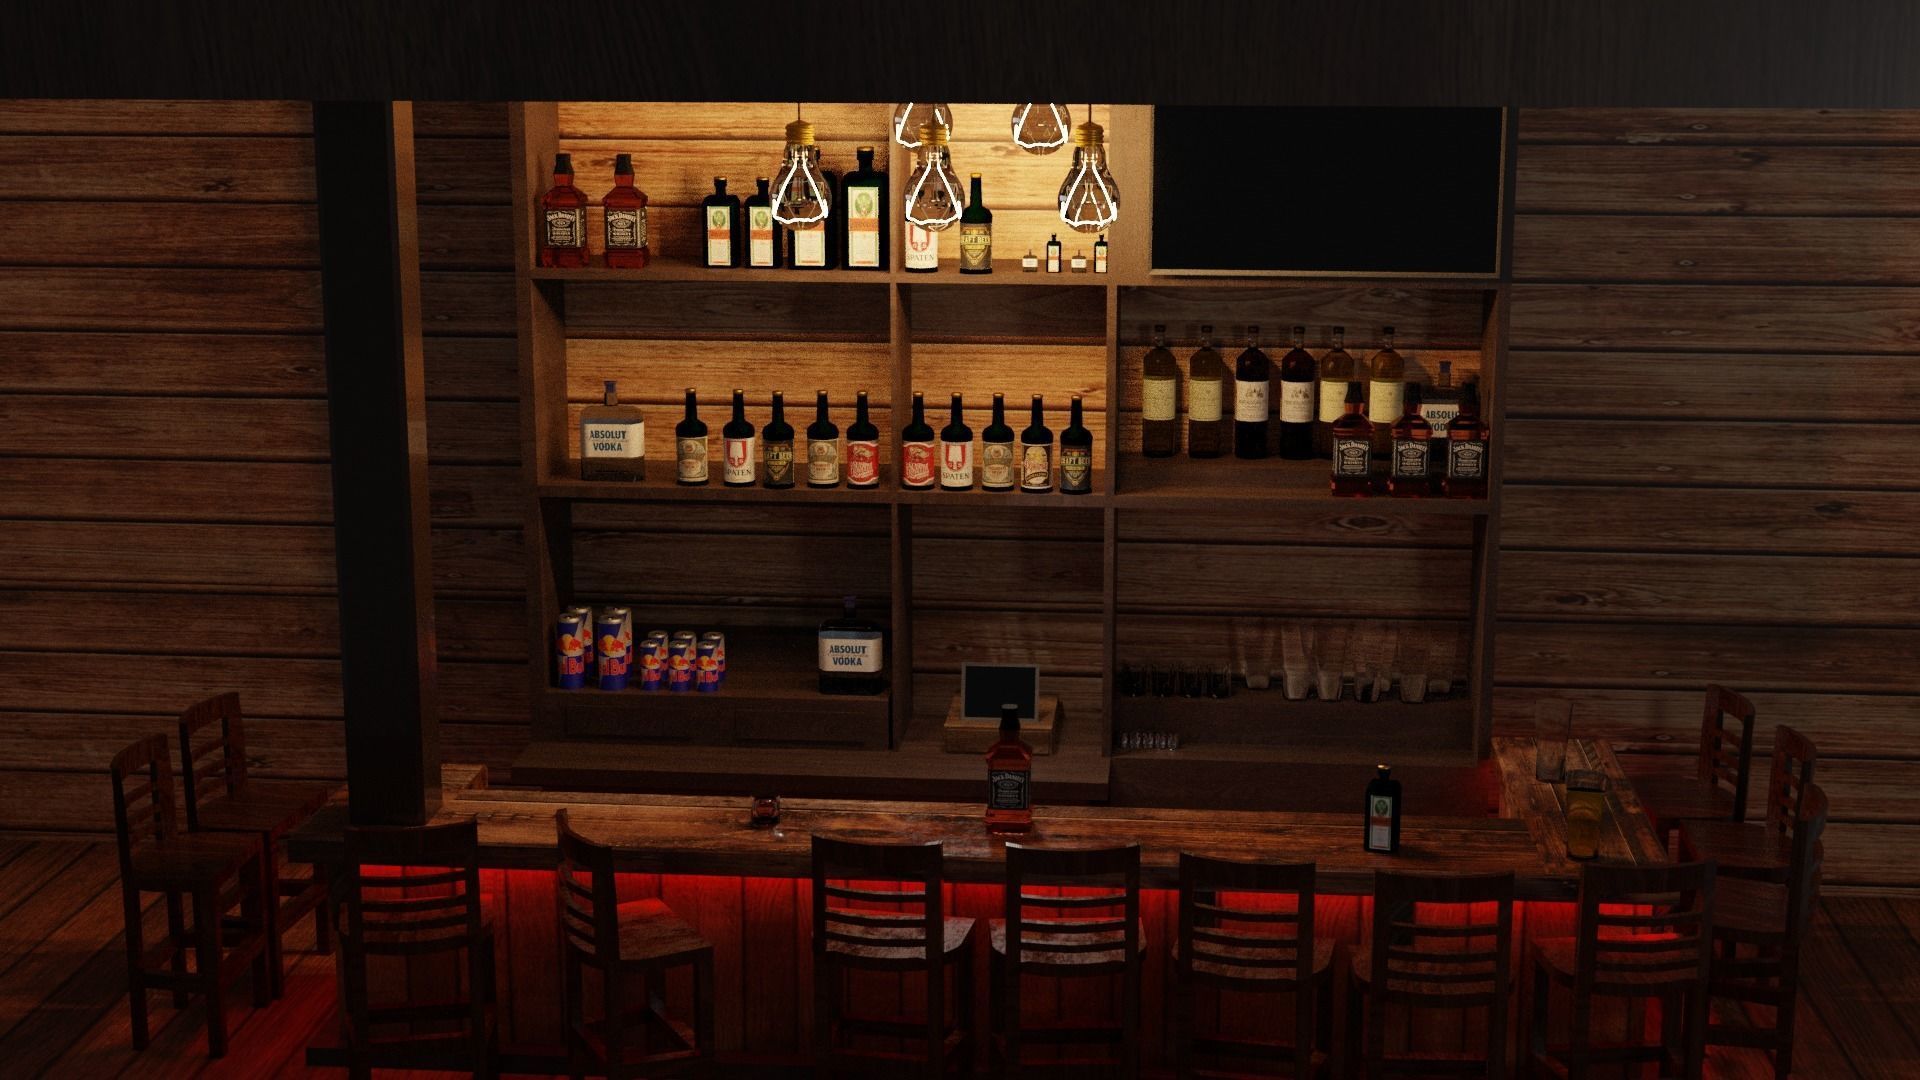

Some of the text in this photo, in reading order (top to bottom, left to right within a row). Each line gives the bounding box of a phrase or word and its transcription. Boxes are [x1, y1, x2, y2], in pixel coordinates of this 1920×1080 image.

[1425, 410, 1460, 419] ABSOLU
[590, 430, 626, 439] ABSOLUT
[593, 442, 622, 451] VODKA
[727, 467, 752, 476] PATEN
[829, 645, 867, 654] ABSOLUT
[832, 657, 863, 666] VODKA
